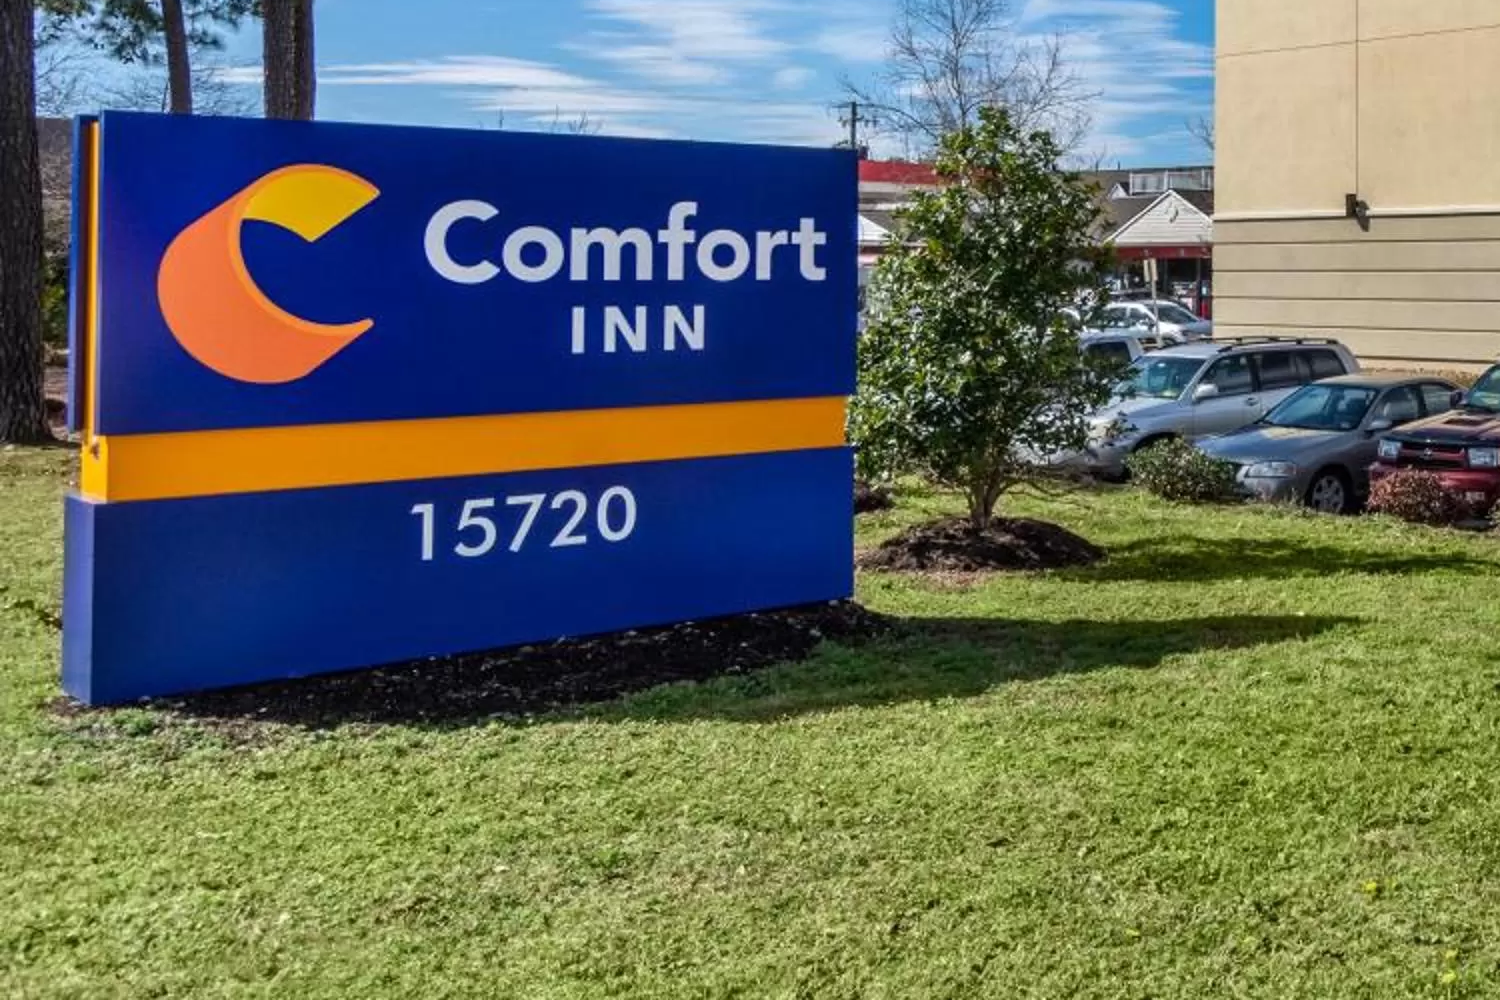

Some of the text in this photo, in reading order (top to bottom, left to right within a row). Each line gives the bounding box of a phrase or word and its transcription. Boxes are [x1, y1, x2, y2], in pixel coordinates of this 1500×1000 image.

[423, 199, 828, 284] Comfort
[571, 304, 706, 355] INN
[410, 485, 638, 562] 15720
